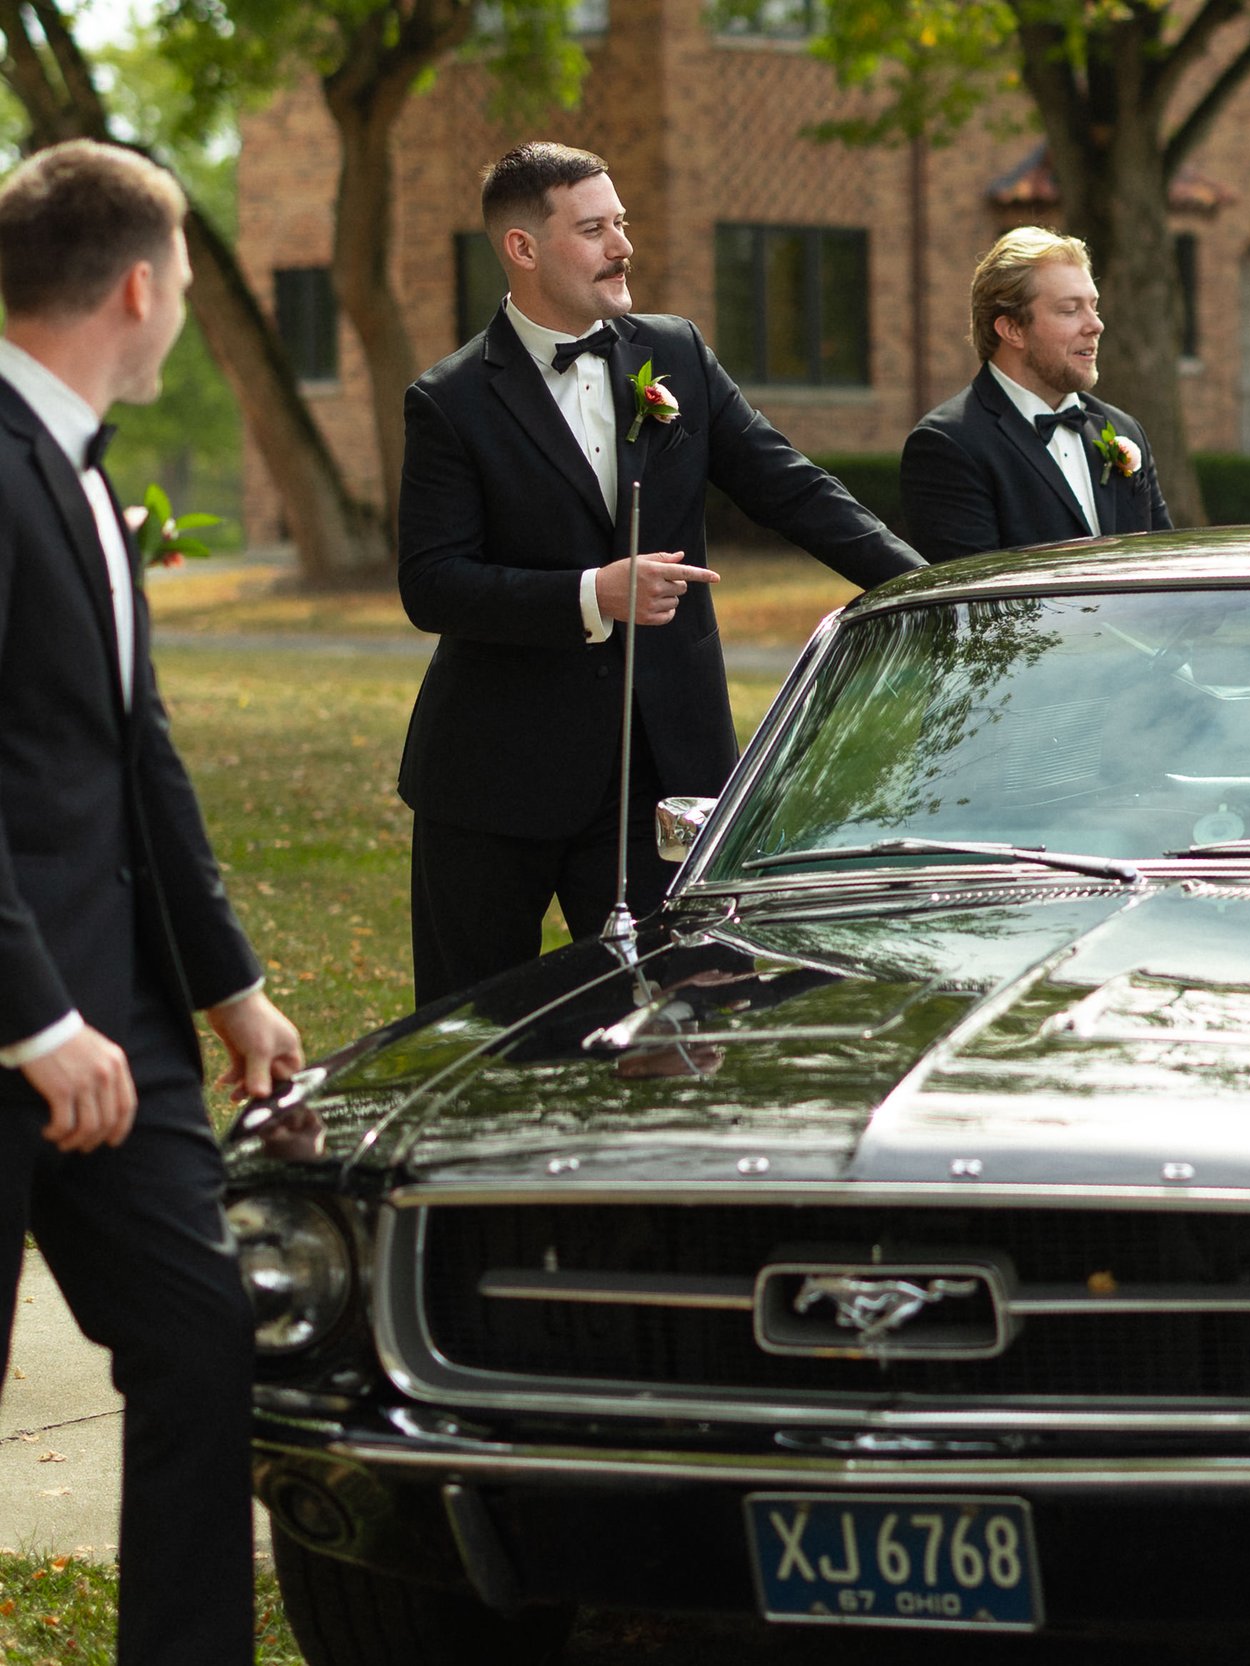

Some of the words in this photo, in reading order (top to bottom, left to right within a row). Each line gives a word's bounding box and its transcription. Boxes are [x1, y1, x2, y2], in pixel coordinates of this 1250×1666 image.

[769, 1510, 861, 1583] XJ
[876, 1511, 1022, 1588] 6768
[838, 1589, 876, 1612] 67
[895, 1591, 963, 1617] OHIO
